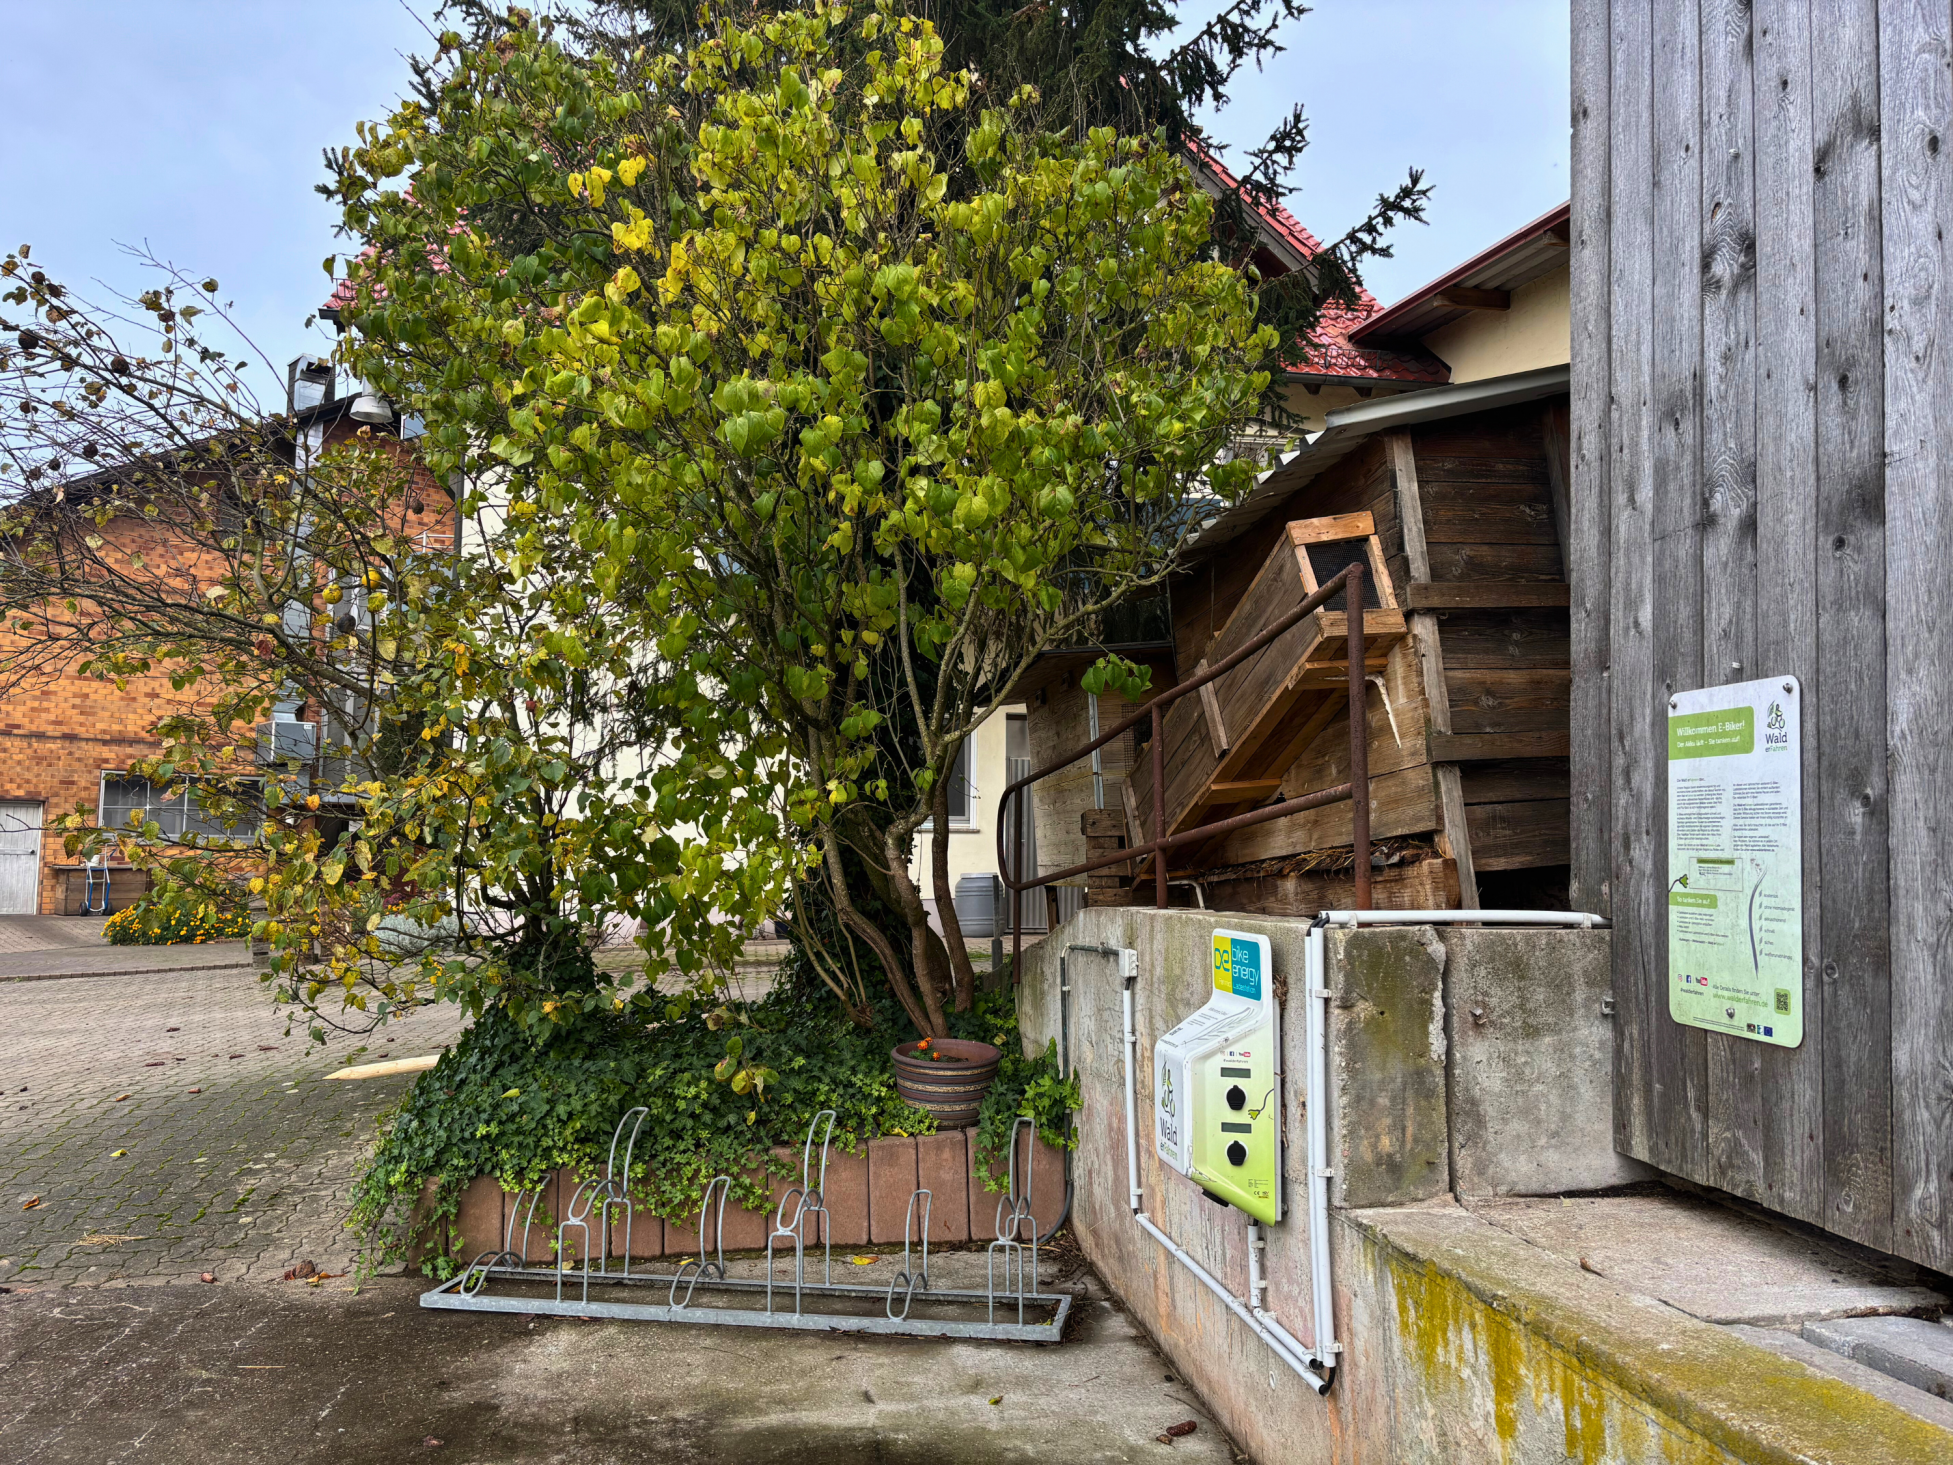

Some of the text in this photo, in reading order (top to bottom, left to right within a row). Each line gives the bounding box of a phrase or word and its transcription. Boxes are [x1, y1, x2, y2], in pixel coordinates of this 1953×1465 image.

[1677, 720, 1745, 736] Willkommen E-Biker!
[1765, 731, 1788, 744] Wald
[1231, 944, 1249, 963] bike
[1232, 964, 1259, 986] energy
[1712, 992, 1768, 1008] www.walderfahren.de
[1160, 1116, 1178, 1146] Wald
